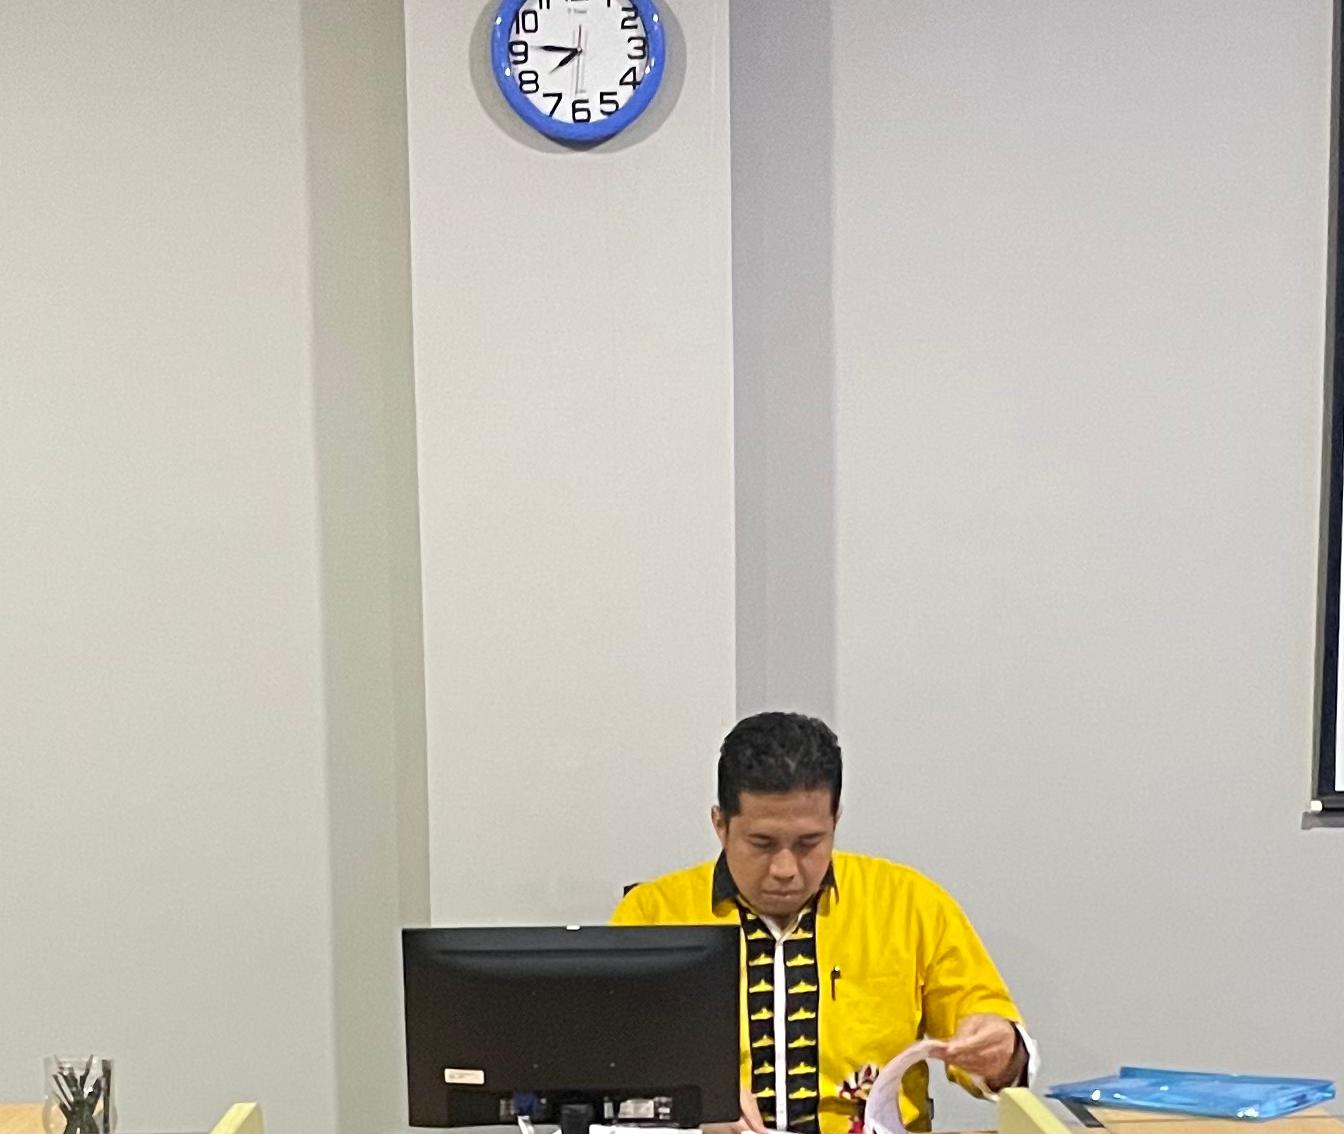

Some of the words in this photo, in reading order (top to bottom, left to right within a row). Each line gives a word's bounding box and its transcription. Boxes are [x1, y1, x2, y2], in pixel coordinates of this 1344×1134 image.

[515, 9, 539, 34] 10
[620, 7, 639, 29] 2
[508, 40, 529, 65] 9
[627, 36, 647, 60] 3
[518, 70, 540, 94] 8
[619, 66, 642, 90] 4
[542, 92, 563, 117] 7
[571, 98, 592, 123] 6
[599, 91, 619, 116] 5
